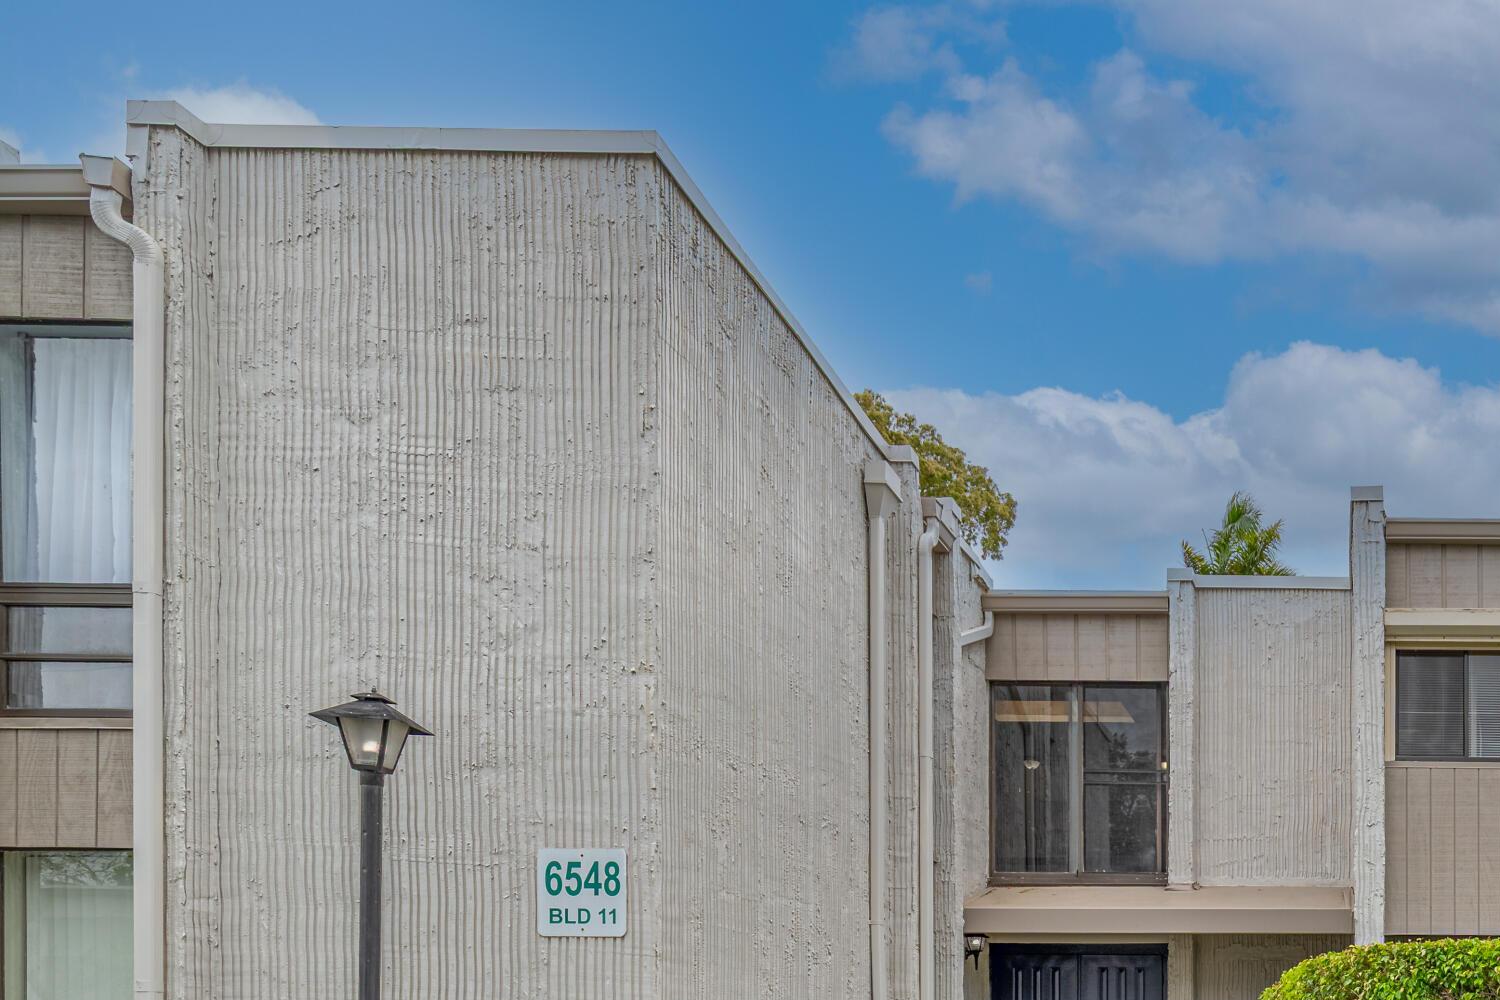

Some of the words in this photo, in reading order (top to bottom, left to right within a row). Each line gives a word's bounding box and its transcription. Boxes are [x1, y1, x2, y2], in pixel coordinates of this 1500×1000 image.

[545, 860, 621, 896] 6548
[549, 908, 591, 924] BLD
[598, 908, 616, 924] 11
